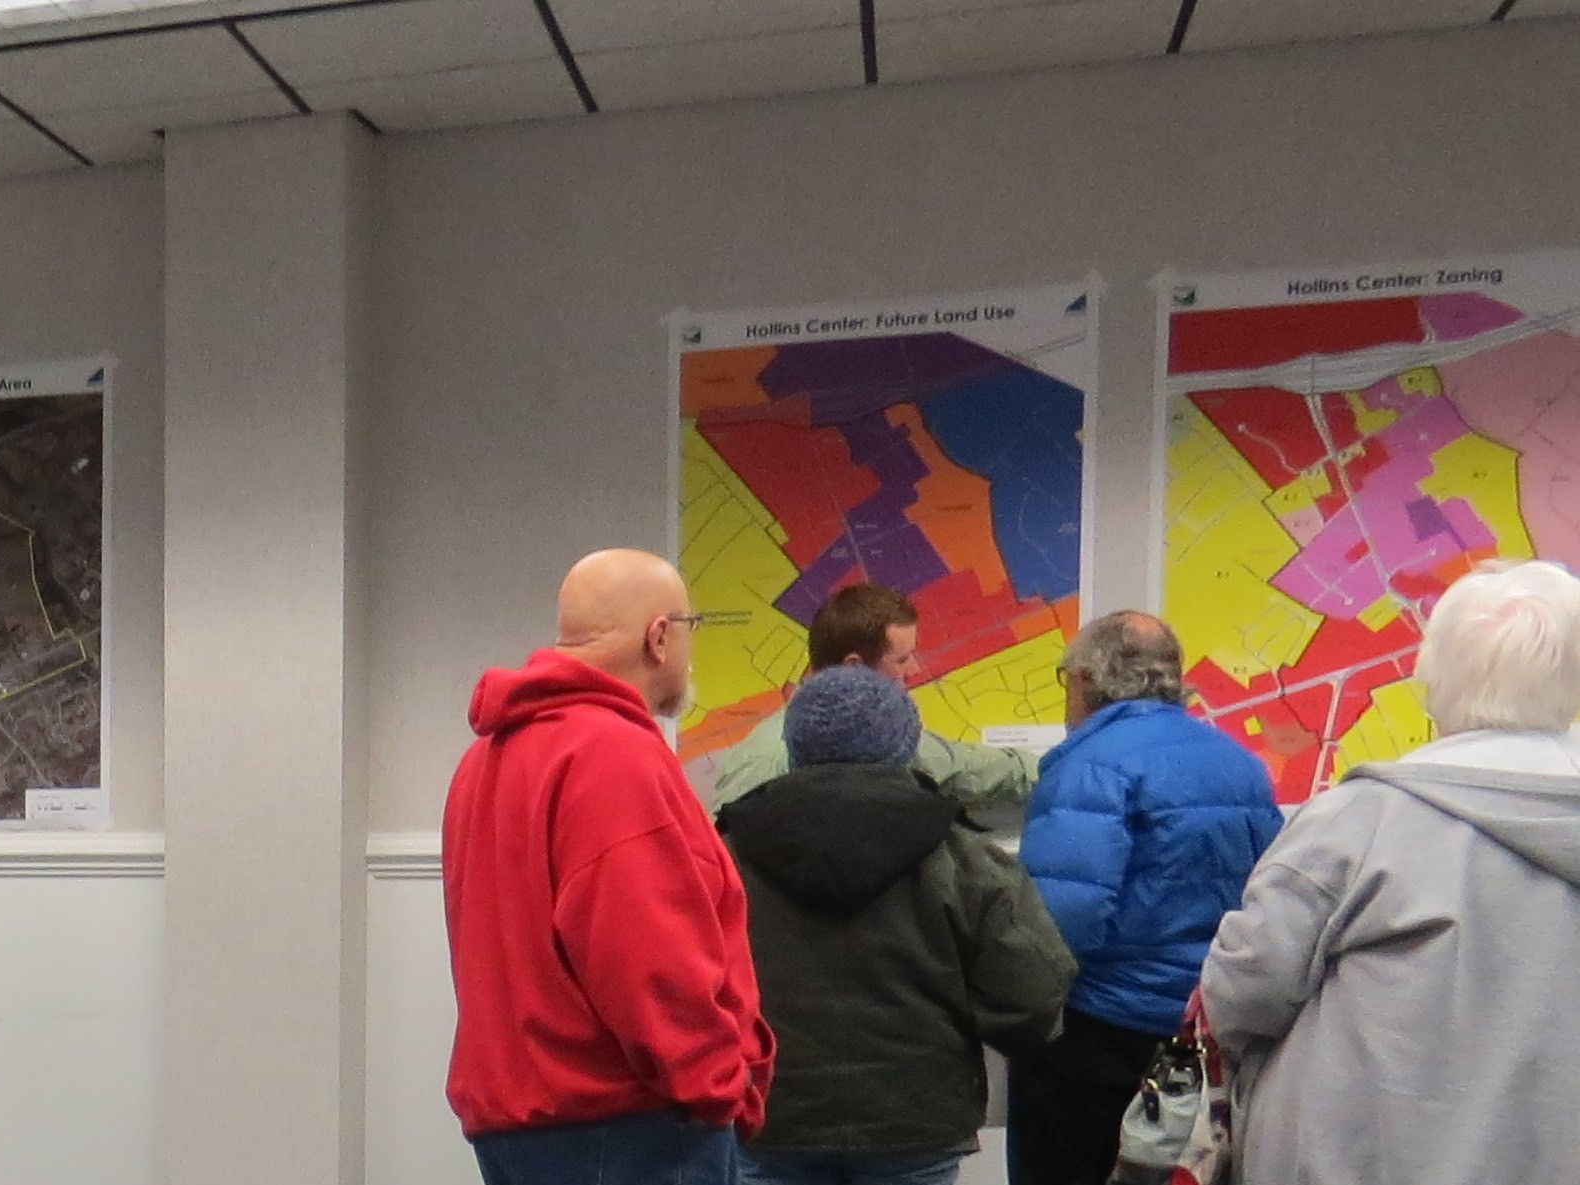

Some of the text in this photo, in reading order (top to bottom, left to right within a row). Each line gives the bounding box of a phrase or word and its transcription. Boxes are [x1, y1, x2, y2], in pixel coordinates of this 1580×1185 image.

[1287, 267, 1503, 295] Hollins Center: Zoning
[746, 304, 1015, 338] Hollins Center: Future Land Use
